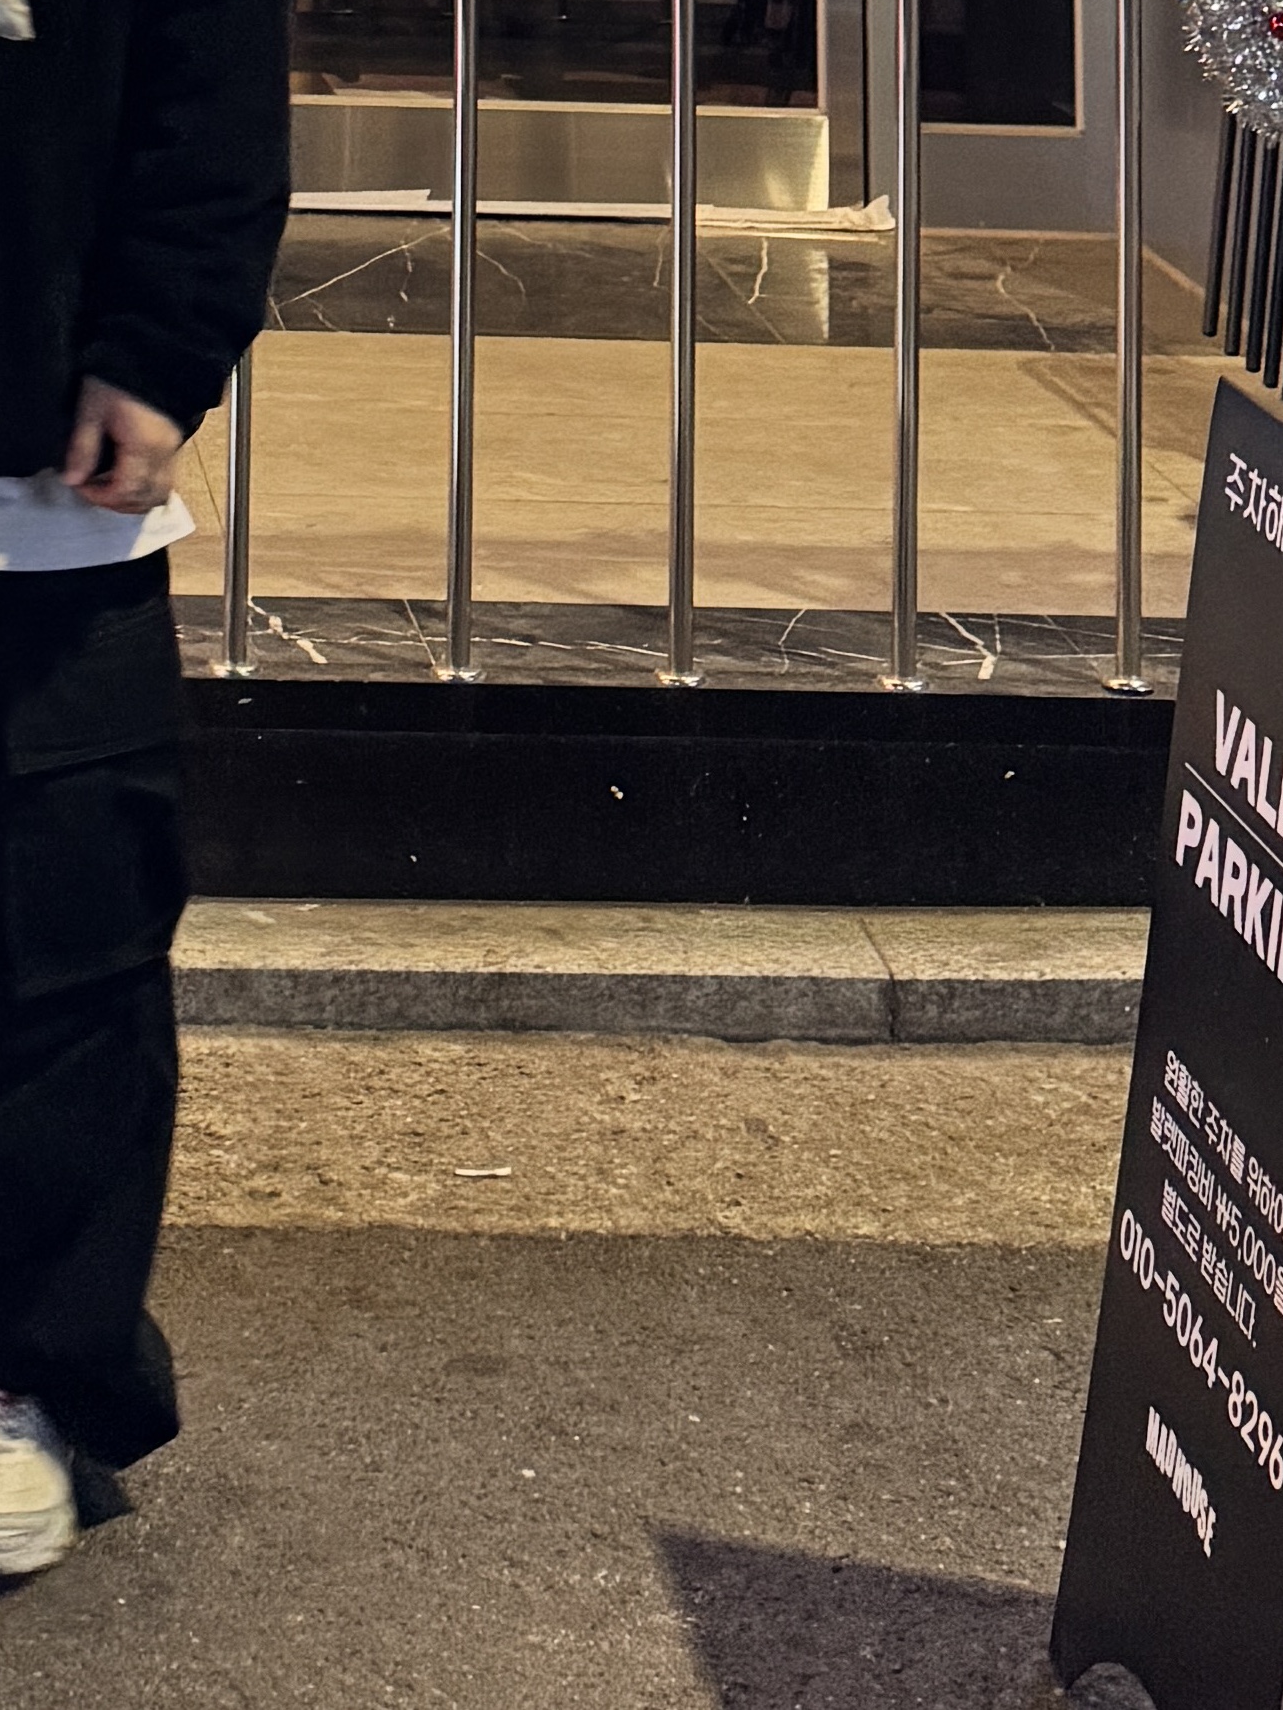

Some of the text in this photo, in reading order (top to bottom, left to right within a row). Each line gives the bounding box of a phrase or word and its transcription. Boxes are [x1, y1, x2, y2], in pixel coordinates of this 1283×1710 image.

[1216, 689, 1283, 838] VAL
[1176, 789, 1283, 984] PARKI
[1150, 1096, 1215, 1211] 발렛파킹비
[1164, 1050, 1204, 1129] 원활한
[1205, 1101, 1246, 1185] 주차를
[1161, 1179, 1257, 1348] 별도로 받습니다.
[1120, 1209, 1283, 1490] 010-5064-8296
[1146, 1406, 1216, 1559] MADHOUSE
